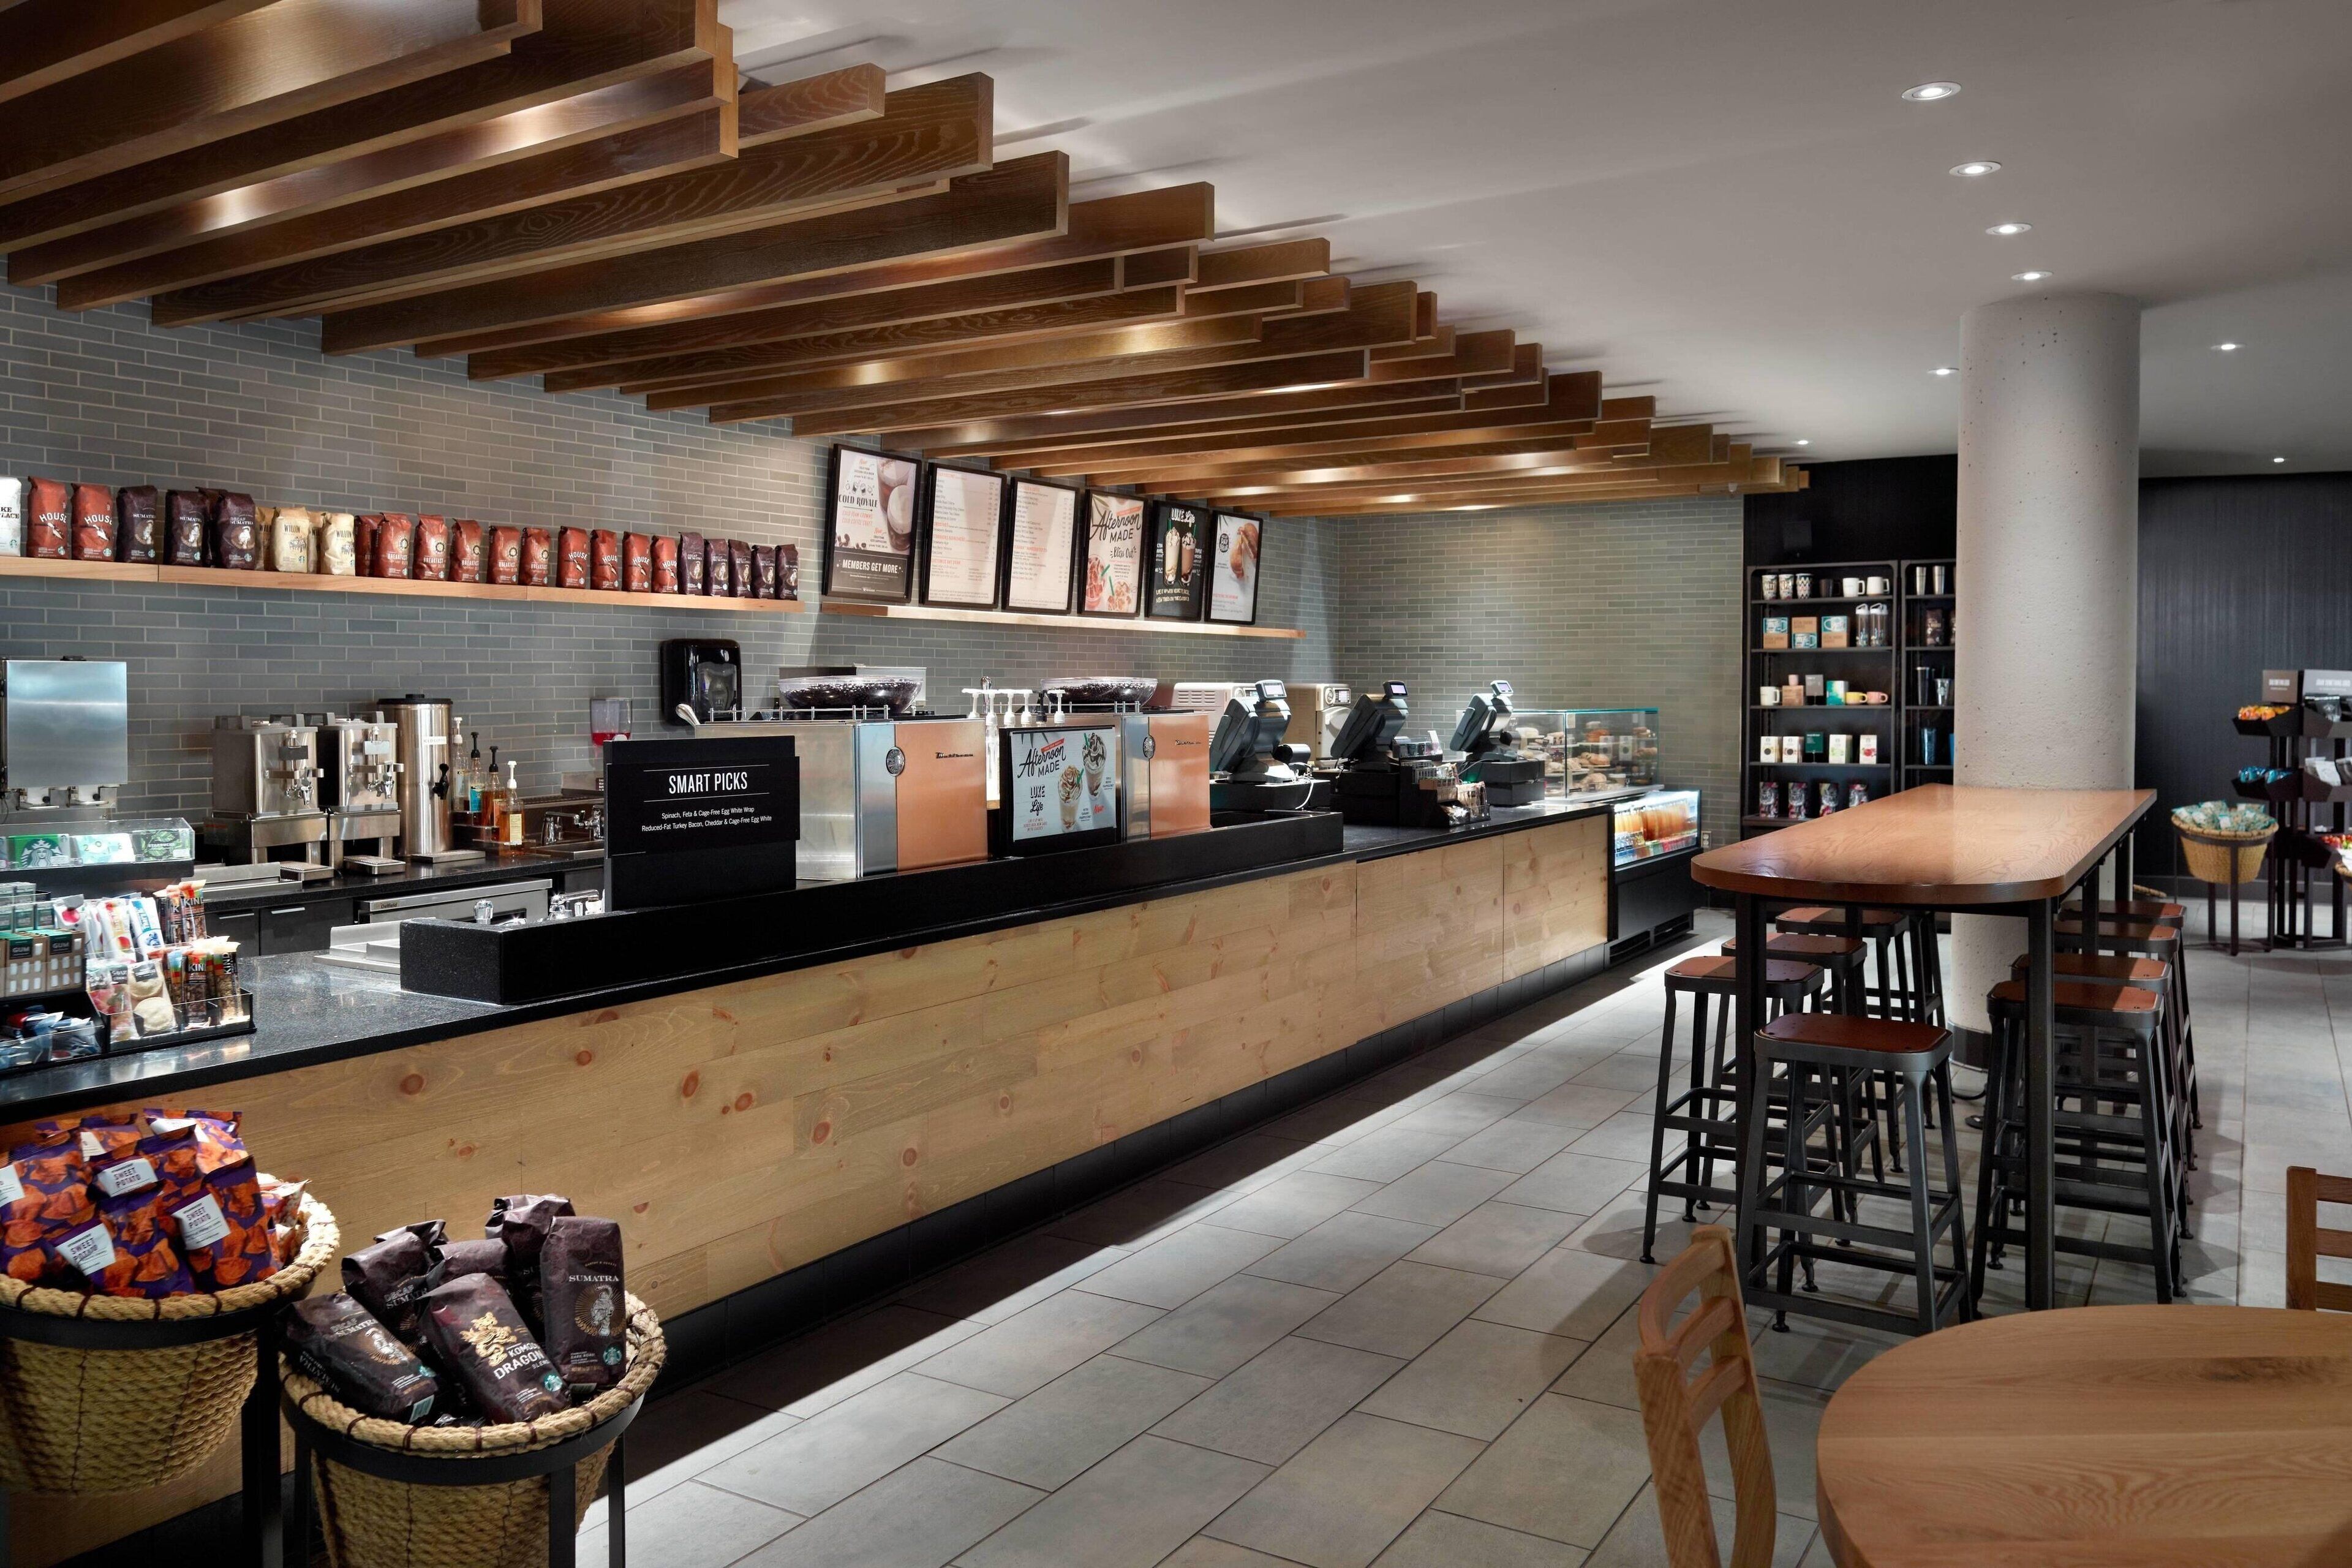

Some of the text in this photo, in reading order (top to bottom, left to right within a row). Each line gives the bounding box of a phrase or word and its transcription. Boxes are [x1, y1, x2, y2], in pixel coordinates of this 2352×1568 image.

[839, 494, 878, 508] COLD ROYALE
[39, 512, 67, 523] HOUSE
[284, 524, 301, 533] WILLOW
[1090, 510, 1142, 541] Afternoon
[336, 530, 353, 538] WILLOW
[1109, 529, 1134, 544] MADE
[568, 551, 588, 560] HOUSE
[601, 554, 618, 564] HOUS
[1114, 546, 1134, 559] Bliss Out
[632, 556, 650, 565] HOUSE
[662, 560, 677, 569] HOUS
[842, 559, 899, 574] MEMBERS GET MORE
[1017, 745, 1066, 778] Afternoon
[1038, 760, 1060, 778] MADE
[669, 771, 748, 794] SMART PICKS
[1030, 785, 1045, 799] LUXE
[662, 811, 681, 820] Spinach,
[698, 809, 720, 817] Cage-Free
[1030, 799, 1044, 816] Life
[642, 823, 671, 832] Reduced-Fat
[729, 816, 750, 826] Cage-Free
[223, 952, 232, 974] KIND
[113, 1167, 135, 1180] SWEET
[116, 1174, 141, 1188] POTATO
[186, 1207, 206, 1221] SWEET
[189, 1213, 211, 1229] POTATO
[70, 1237, 95, 1254] SWEET
[383, 1284, 415, 1302] DECAF
[386, 1287, 428, 1310] SUMATR
[508, 1342, 541, 1358] KOMOD
[493, 1350, 545, 1380] DRAGON
